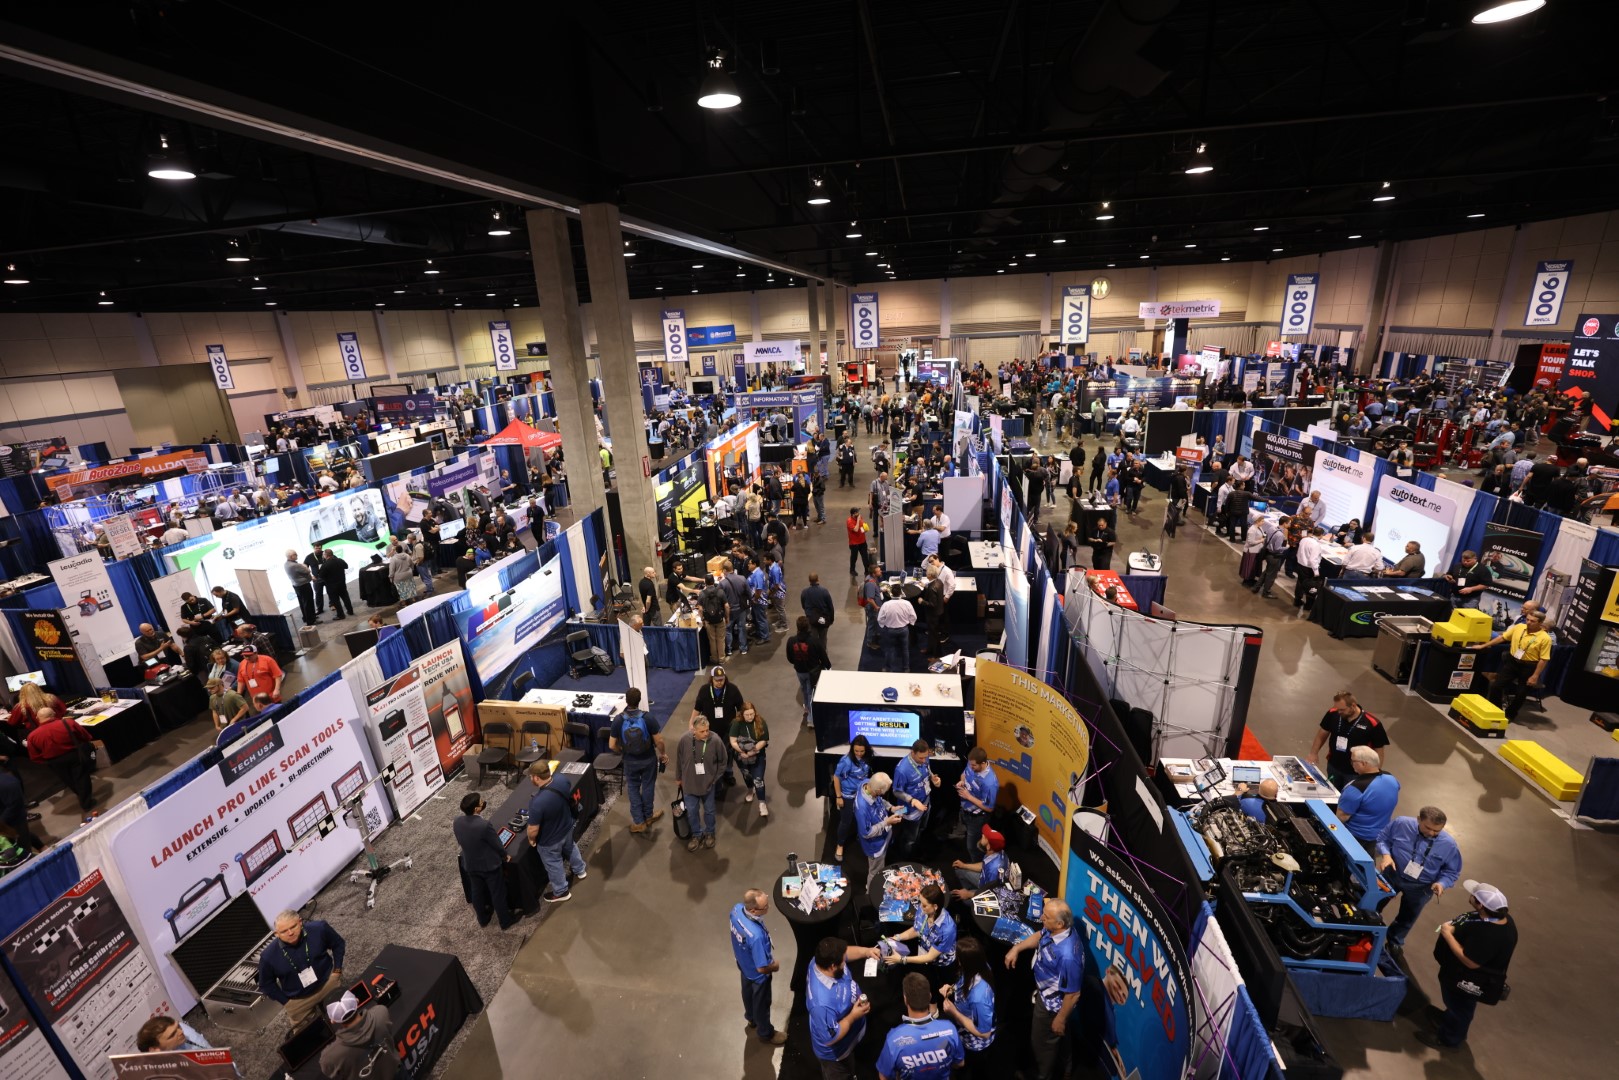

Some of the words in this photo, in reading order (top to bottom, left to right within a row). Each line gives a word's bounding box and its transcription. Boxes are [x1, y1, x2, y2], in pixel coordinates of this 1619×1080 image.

[1536, 277, 1560, 316] 900
[1068, 301, 1083, 335] 700
[1172, 304, 1215, 313] tekmetric
[1289, 290, 1308, 326] 800
[858, 306, 872, 340] 600
[498, 334, 510, 364] 400
[668, 324, 682, 354] 500
[755, 346, 782, 354] MWACA
[1544, 346, 1568, 354] LEAR
[345, 344, 360, 372] 300
[1542, 356, 1566, 364] YOUR
[1572, 358, 1596, 368] TALK
[1574, 348, 1600, 358] LET'S
[214, 356, 228, 383] 200
[1540, 365, 1562, 374] TIME.
[1568, 368, 1596, 378] SHOP.
[1266, 434, 1288, 446] 600,000
[1265, 443, 1274, 451] YOU
[1274, 446, 1291, 456] SHOULD
[1292, 450, 1303, 460] TOO.
[88, 464, 140, 480] AutoZone
[144, 459, 186, 474] ALLDAT
[110, 526, 130, 536] DIESEL
[1502, 548, 1528, 557] Services
[421, 650, 453, 669] LAUNCH
[423, 662, 441, 674] TECH
[442, 656, 454, 667] USA
[424, 673, 444, 687] ROXIE
[1010, 672, 1038, 694] THIS
[1040, 688, 1088, 744] MARKETING
[232, 754, 256, 774] TECH
[257, 742, 275, 756] USA
[151, 814, 214, 868] LAUNCH
[217, 792, 246, 820] PRO
[248, 768, 278, 796] LINE
[280, 744, 310, 772] SCAN
[312, 718, 344, 747] TOOLS
[186, 825, 229, 861] EXTENSIVE
[244, 790, 276, 816] UPDATED
[288, 745, 334, 782] BI-DIRECTIONAL
[73, 871, 98, 892] LAUNCH
[1088, 849, 1104, 866] We
[1106, 864, 1133, 895] asked
[1133, 892, 1153, 919] shop
[1154, 918, 1177, 961] owners
[34, 918, 50, 934] ADAS
[50, 901, 72, 920] MOBILE
[1086, 870, 1148, 948] THEN
[1152, 938, 1178, 1007] WE
[70, 960, 89, 978] ADAS
[88, 930, 125, 965] Calibration
[1080, 916, 1144, 1008] THEM.
[1083, 895, 1176, 1042] SOLVED
[404, 1024, 439, 1070] USA
[143, 1062, 178, 1070] Throttle
[902, 1048, 948, 1070] SHOP
